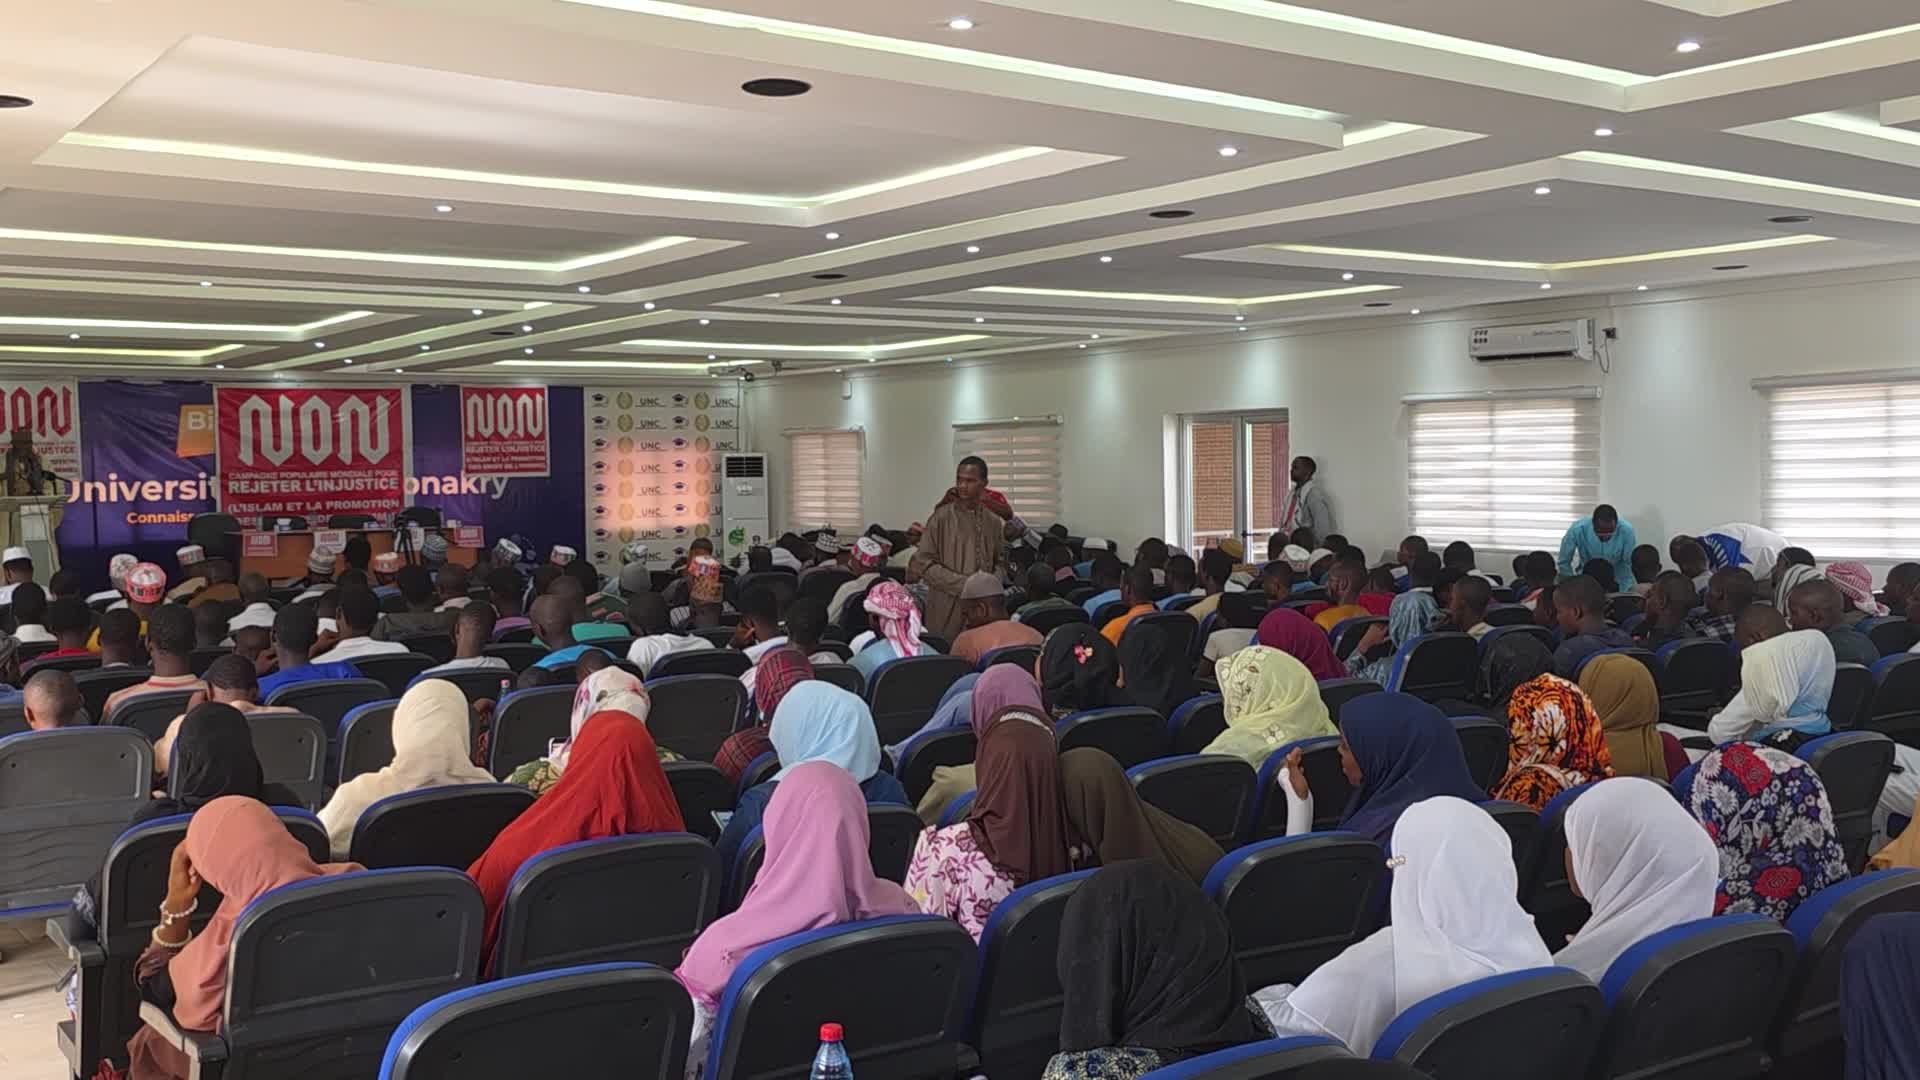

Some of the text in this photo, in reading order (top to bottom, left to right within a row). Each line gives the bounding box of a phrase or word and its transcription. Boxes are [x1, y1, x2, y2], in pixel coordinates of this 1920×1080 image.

[640, 397, 660, 406] UNC
[714, 397, 735, 406] UNC
[0, 386, 72, 437] ON
[466, 393, 545, 438] NON
[640, 419, 660, 428] UNC
[715, 419, 734, 428] UNC
[238, 394, 392, 466] NON
[640, 441, 661, 450] UNC
[715, 441, 734, 450] UNC
[641, 464, 661, 472] UNC
[228, 478, 399, 494] REJETER L'INJUSTICE
[403, 470, 510, 499] onakry
[641, 486, 661, 494] UNC
[286, 502, 304, 511] ET
[305, 501, 322, 511] LA
[325, 499, 400, 510] PROMOTION
[641, 508, 661, 516] UNC
[641, 530, 662, 538] UNC
